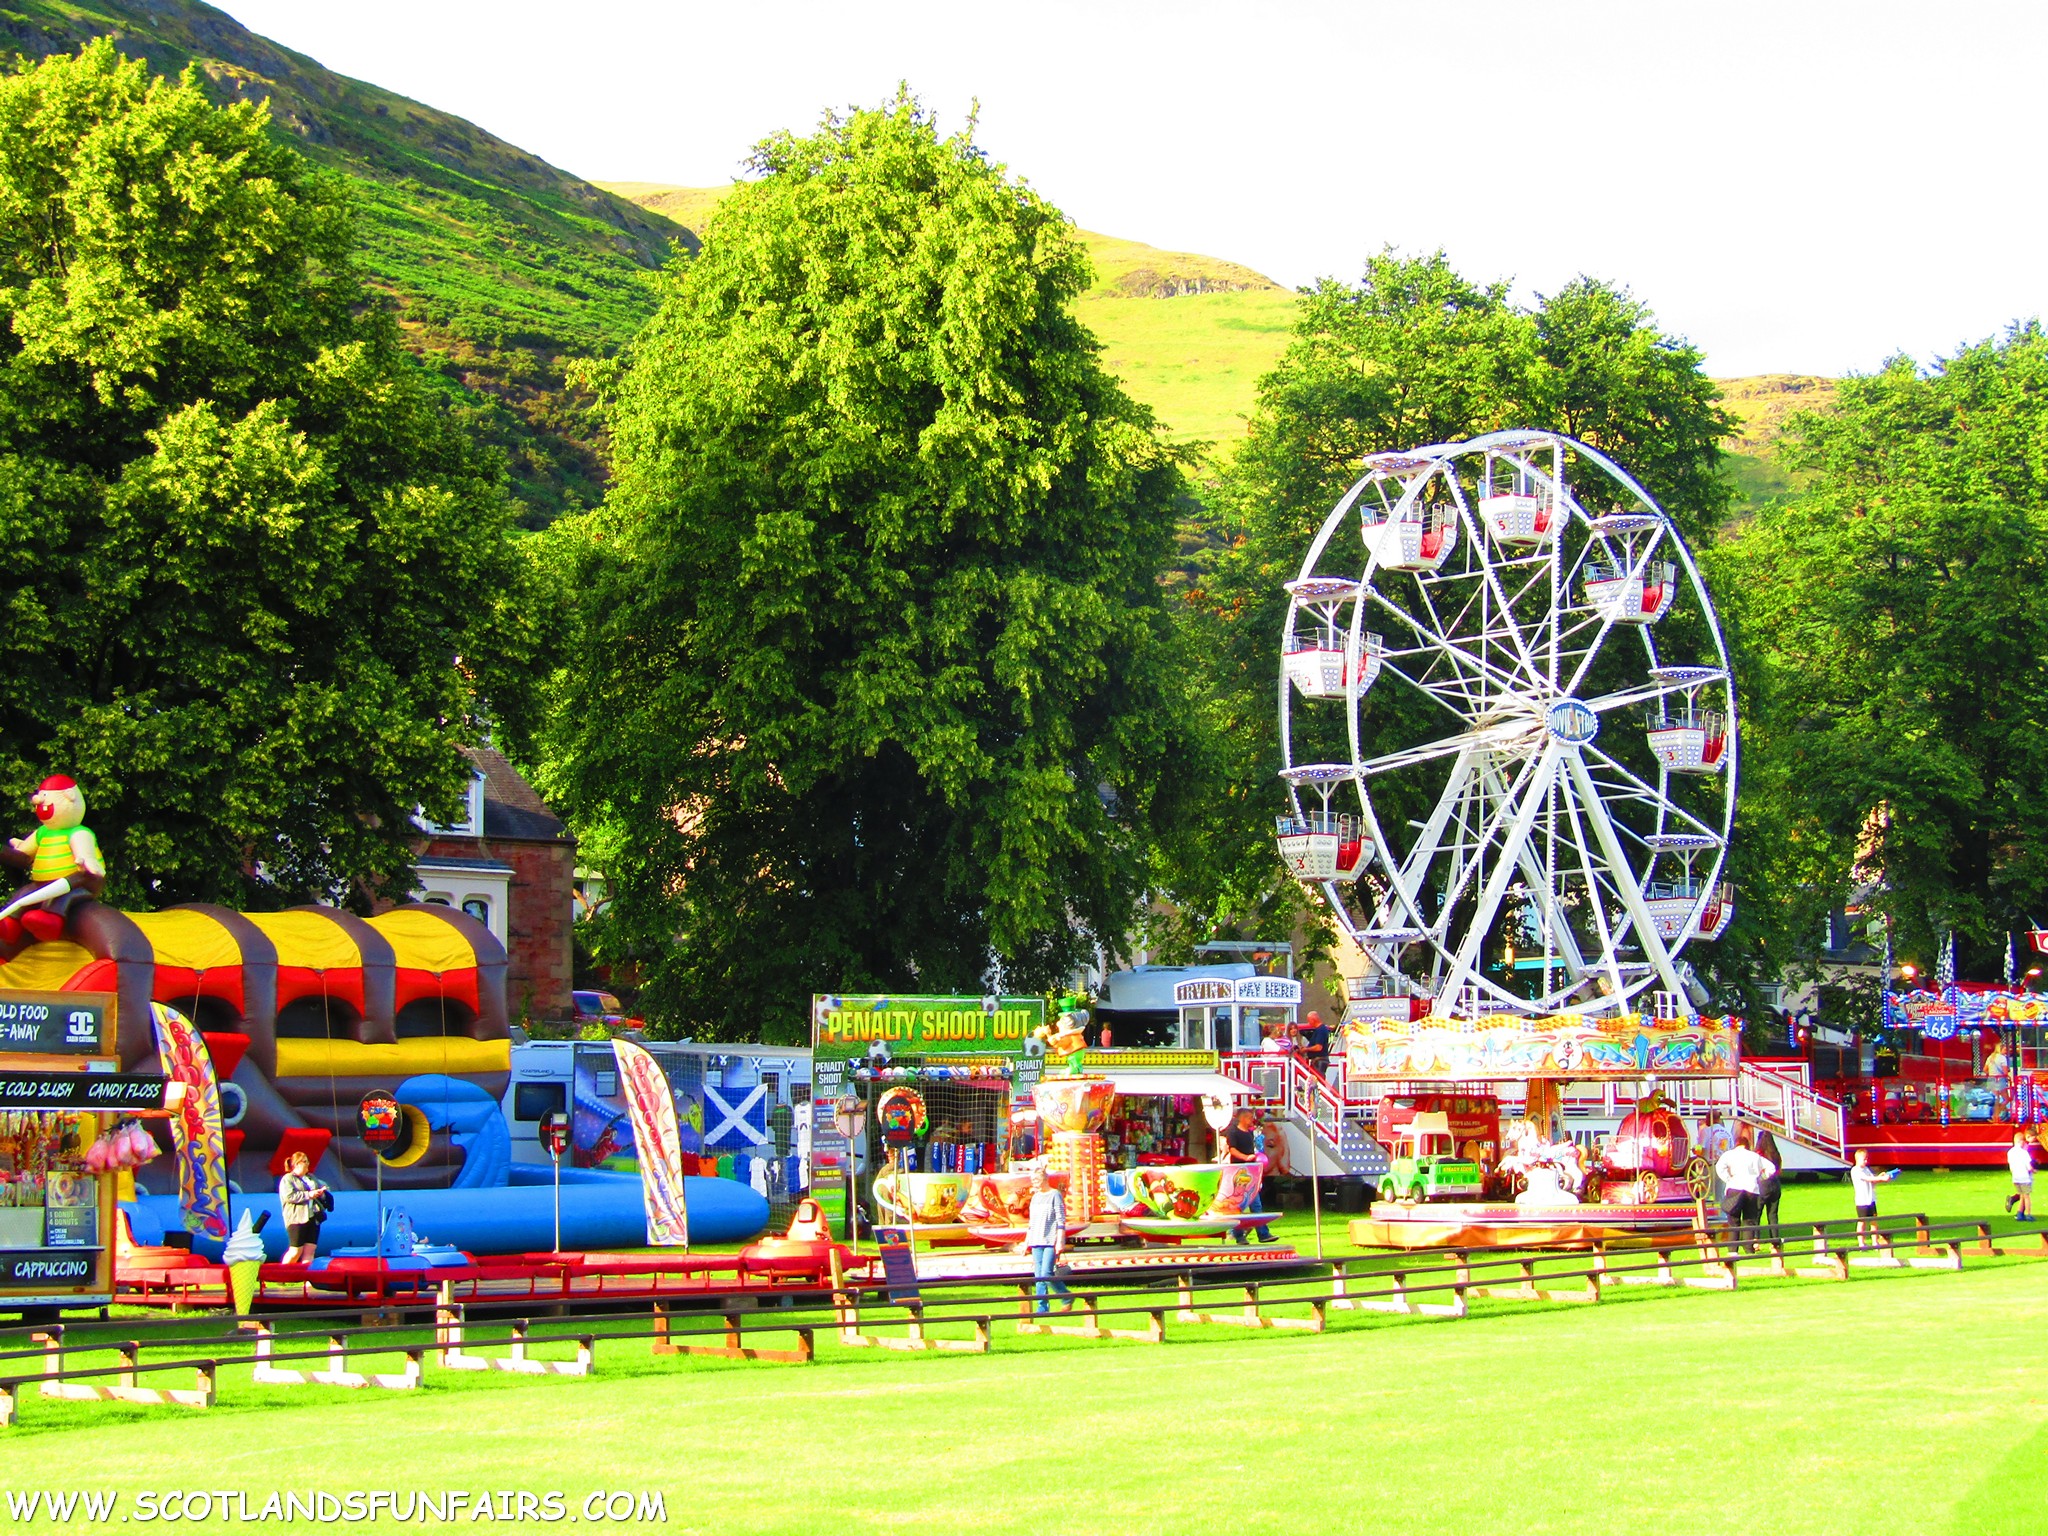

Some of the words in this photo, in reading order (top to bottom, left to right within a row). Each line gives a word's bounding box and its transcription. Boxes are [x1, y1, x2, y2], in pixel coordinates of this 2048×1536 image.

[1498, 520, 1506, 531] 5
[1304, 676, 1313, 687] 2
[1666, 751, 1675, 761] 3
[1296, 859, 1305, 870] 3
[1664, 920, 1673, 930] 2
[20, 1005, 49, 1020] FOOD
[827, 1011, 917, 1042] PENALTY
[922, 1010, 989, 1041] SHOOT
[993, 1010, 1031, 1040] OUT
[1931, 1022, 1949, 1035] 66
[815, 1061, 846, 1073] PENALTY
[1015, 1059, 1043, 1071] PENALTY
[818, 1073, 842, 1084] SHOOT
[1018, 1071, 1040, 1082] SHOOT
[6, 1081, 37, 1097] COLD
[38, 1082, 75, 1097] SLUSH
[88, 1082, 127, 1099] CANDY
[125, 1083, 162, 1099] FLOSS
[823, 1085, 837, 1096] OUT
[1023, 1082, 1035, 1093] OU
[54, 1218, 79, 1226] DONUTS
[15, 1260, 88, 1278] CAPPUCCINO
